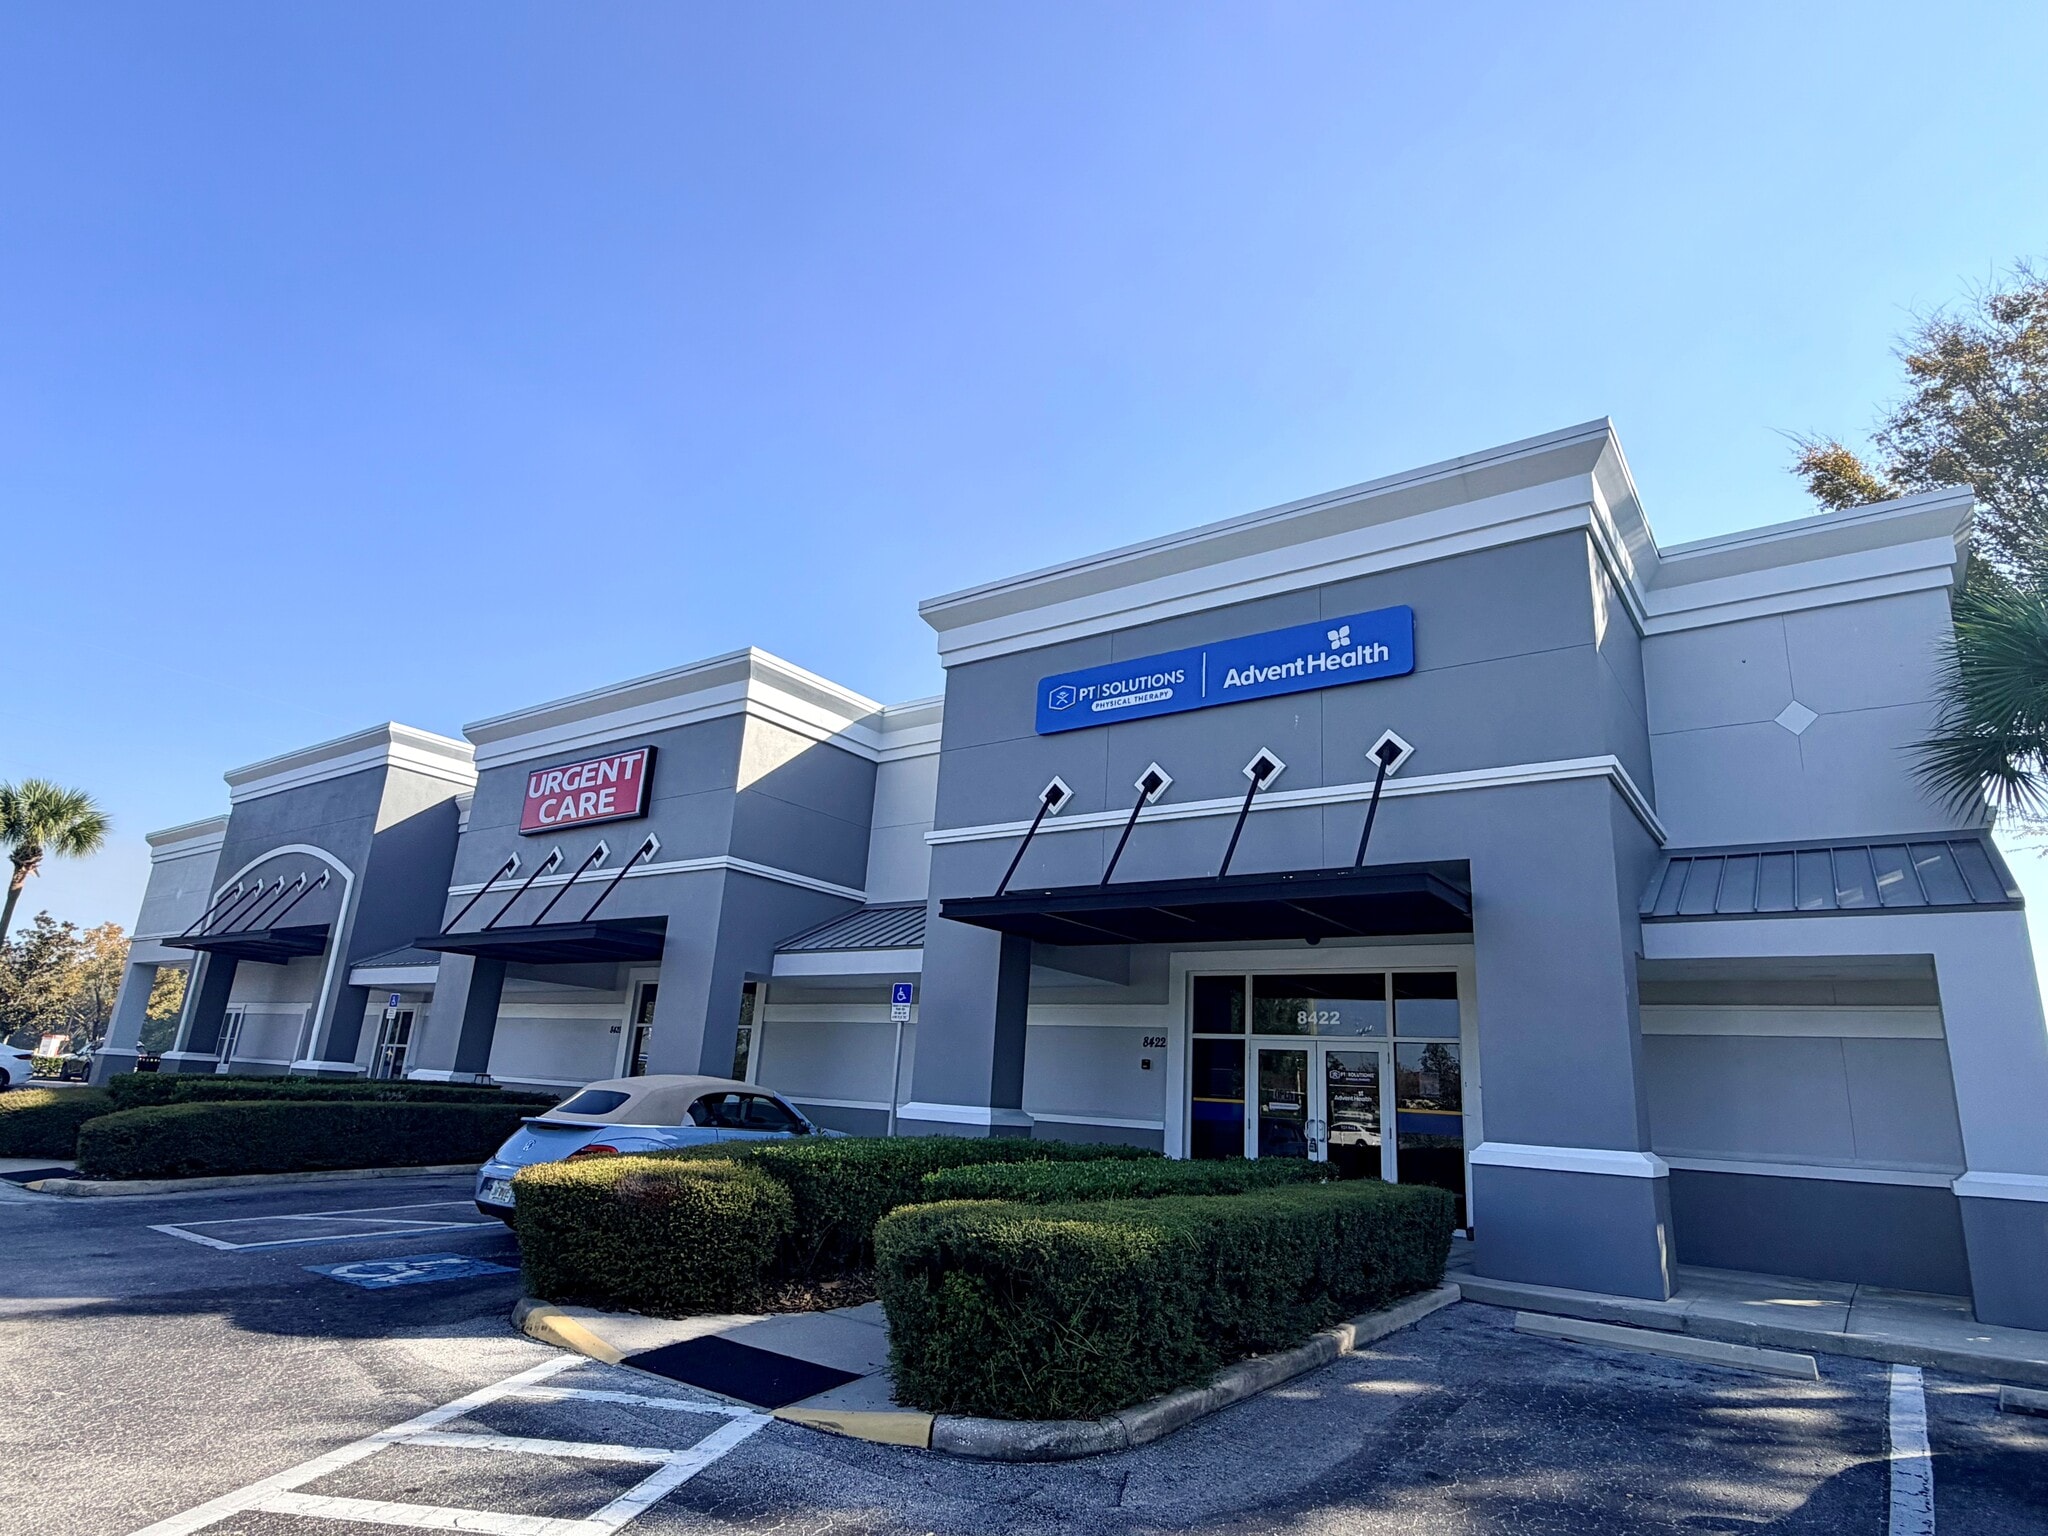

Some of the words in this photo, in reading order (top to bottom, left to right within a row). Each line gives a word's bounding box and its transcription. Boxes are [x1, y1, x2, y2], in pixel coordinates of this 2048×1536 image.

[1101, 669, 1185, 697] SOLUTIONS
[1095, 698, 1131, 710] PHYSICAL
[1134, 690, 1169, 703] THERAPY
[529, 753, 641, 798] URGENT
[538, 787, 616, 824] CARE
[1297, 1011, 1340, 1024] 8422
[1142, 1036, 1167, 1048] 8422
